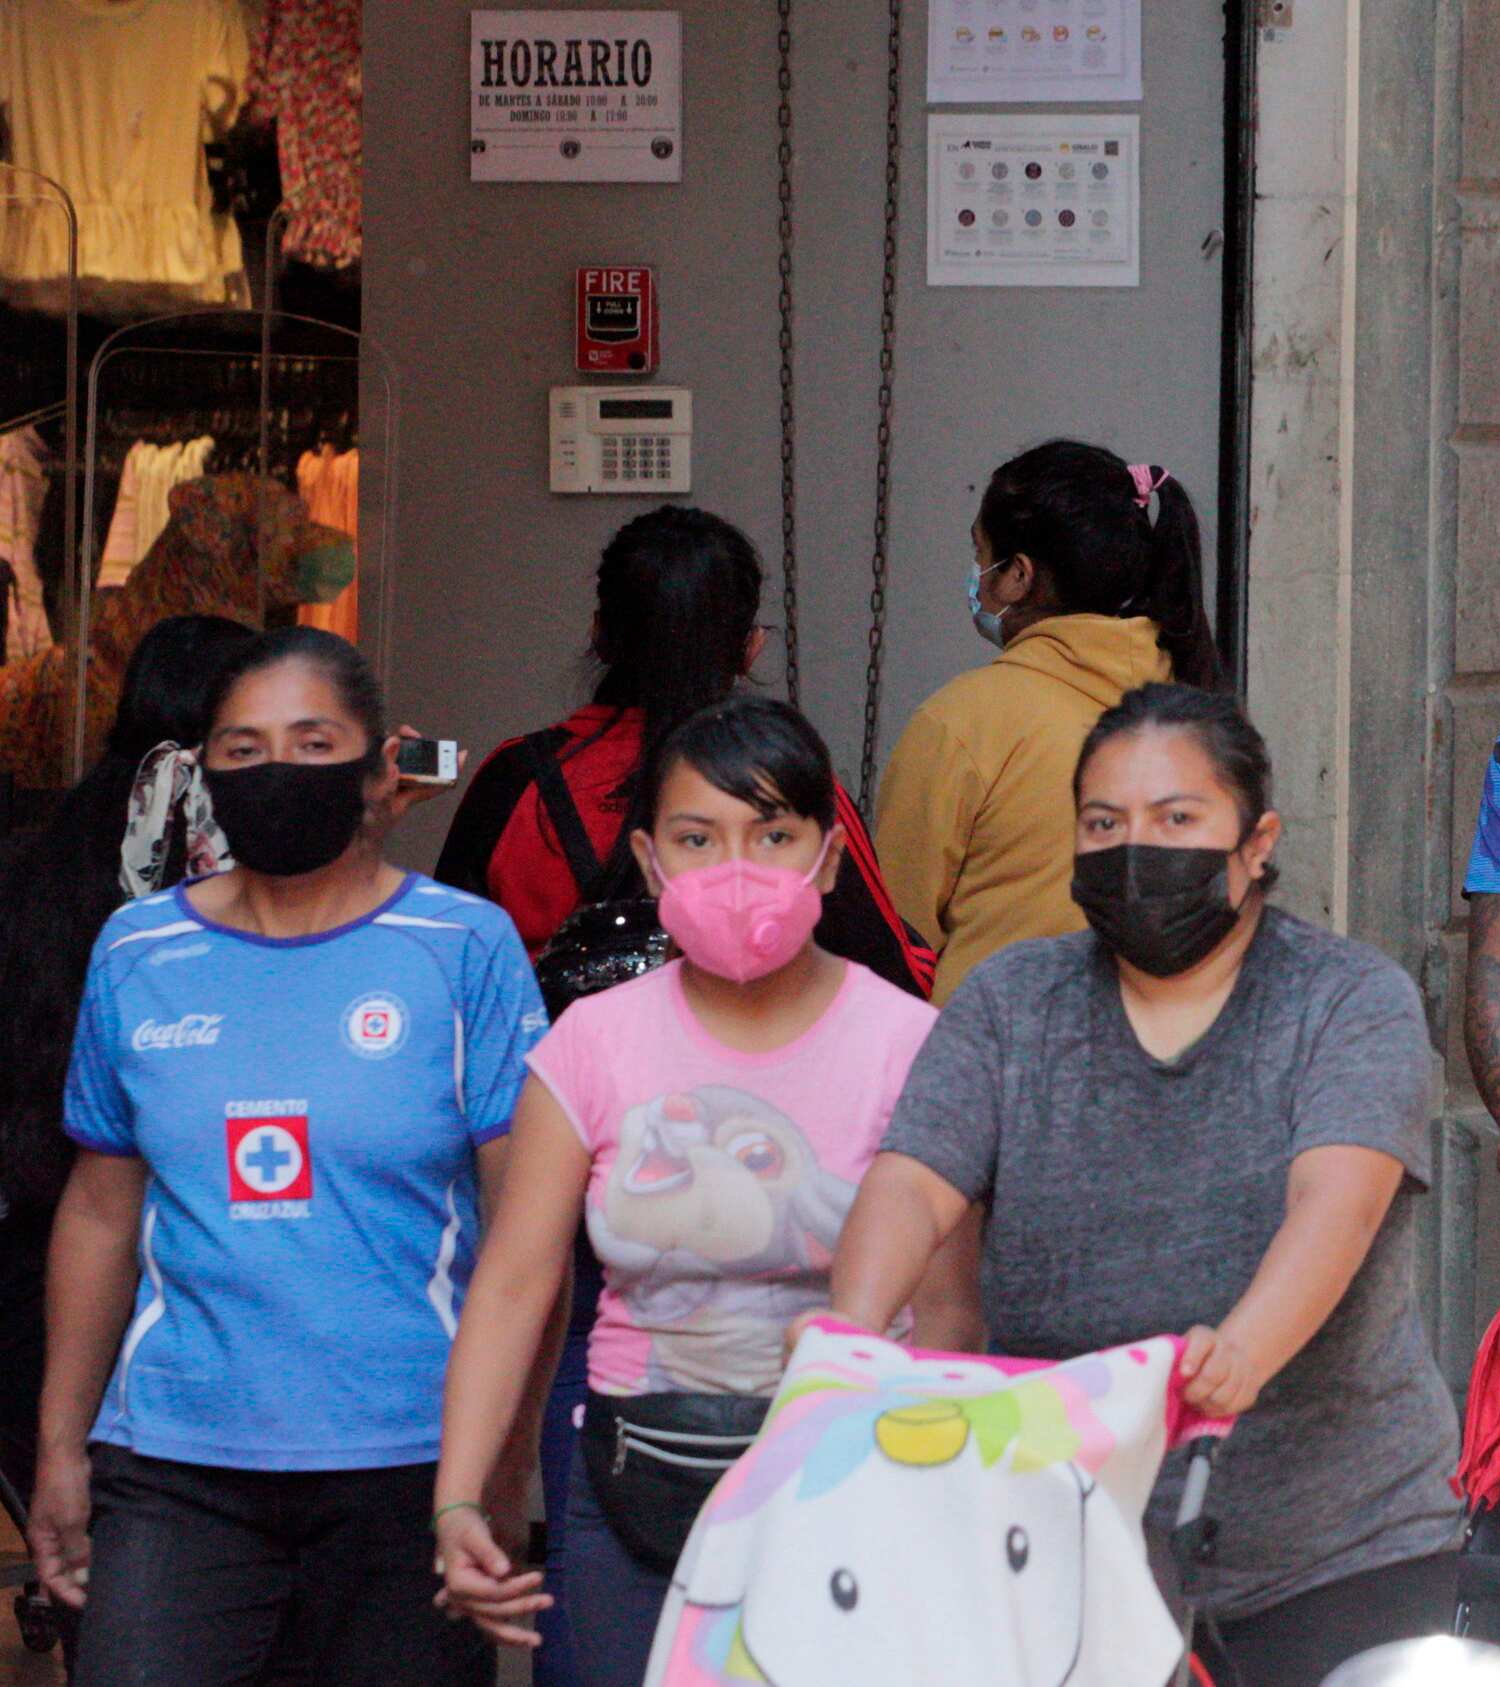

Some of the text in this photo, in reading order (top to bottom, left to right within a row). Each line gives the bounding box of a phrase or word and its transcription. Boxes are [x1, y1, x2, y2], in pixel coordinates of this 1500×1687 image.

[480, 39, 652, 88] HORARIO
[479, 95, 490, 107] DE
[535, 95, 542, 107] A
[621, 95, 627, 107] A
[510, 110, 550, 123] DOMINGO
[590, 110, 597, 123] A
[585, 271, 642, 293] FIRE
